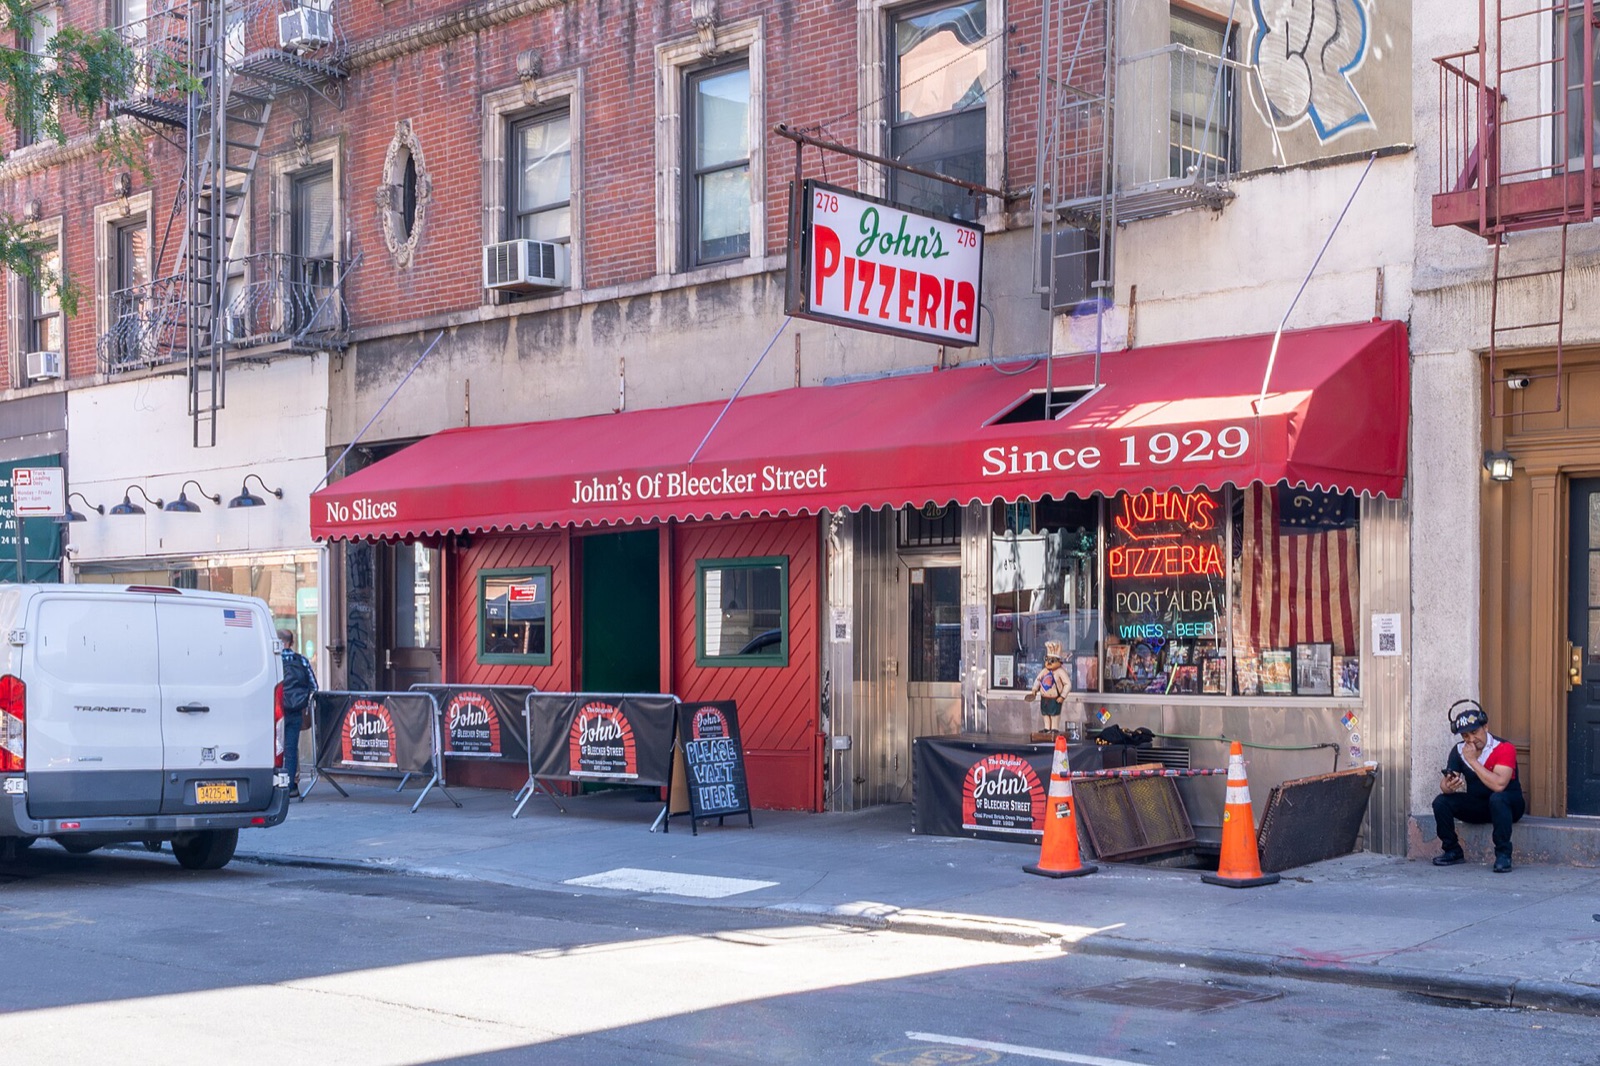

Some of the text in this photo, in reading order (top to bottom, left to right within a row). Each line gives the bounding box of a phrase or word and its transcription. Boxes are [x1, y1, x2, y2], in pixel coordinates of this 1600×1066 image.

[815, 192, 839, 213] 278
[856, 207, 949, 259] John's
[957, 229, 977, 247] 278
[982, 426, 1250, 477] Since 1929
[572, 464, 828, 504] John's Of Bleecker Street
[326, 498, 397, 522] No Slices
[1116, 491, 1215, 530] JOHN'S
[1110, 544, 1225, 579] PIZZERIA
[1119, 624, 1164, 638] WINES
[1176, 622, 1214, 637] BEER
[350, 711, 389, 738] John's
[450, 703, 491, 730] John's
[579, 714, 625, 746] John's
[686, 739, 737, 765] PLEASE
[693, 762, 735, 784] WAIT
[973, 766, 1033, 799] John's
[699, 784, 739, 810] HERE
[976, 798, 1031, 812] OF BLEECKER STREET
